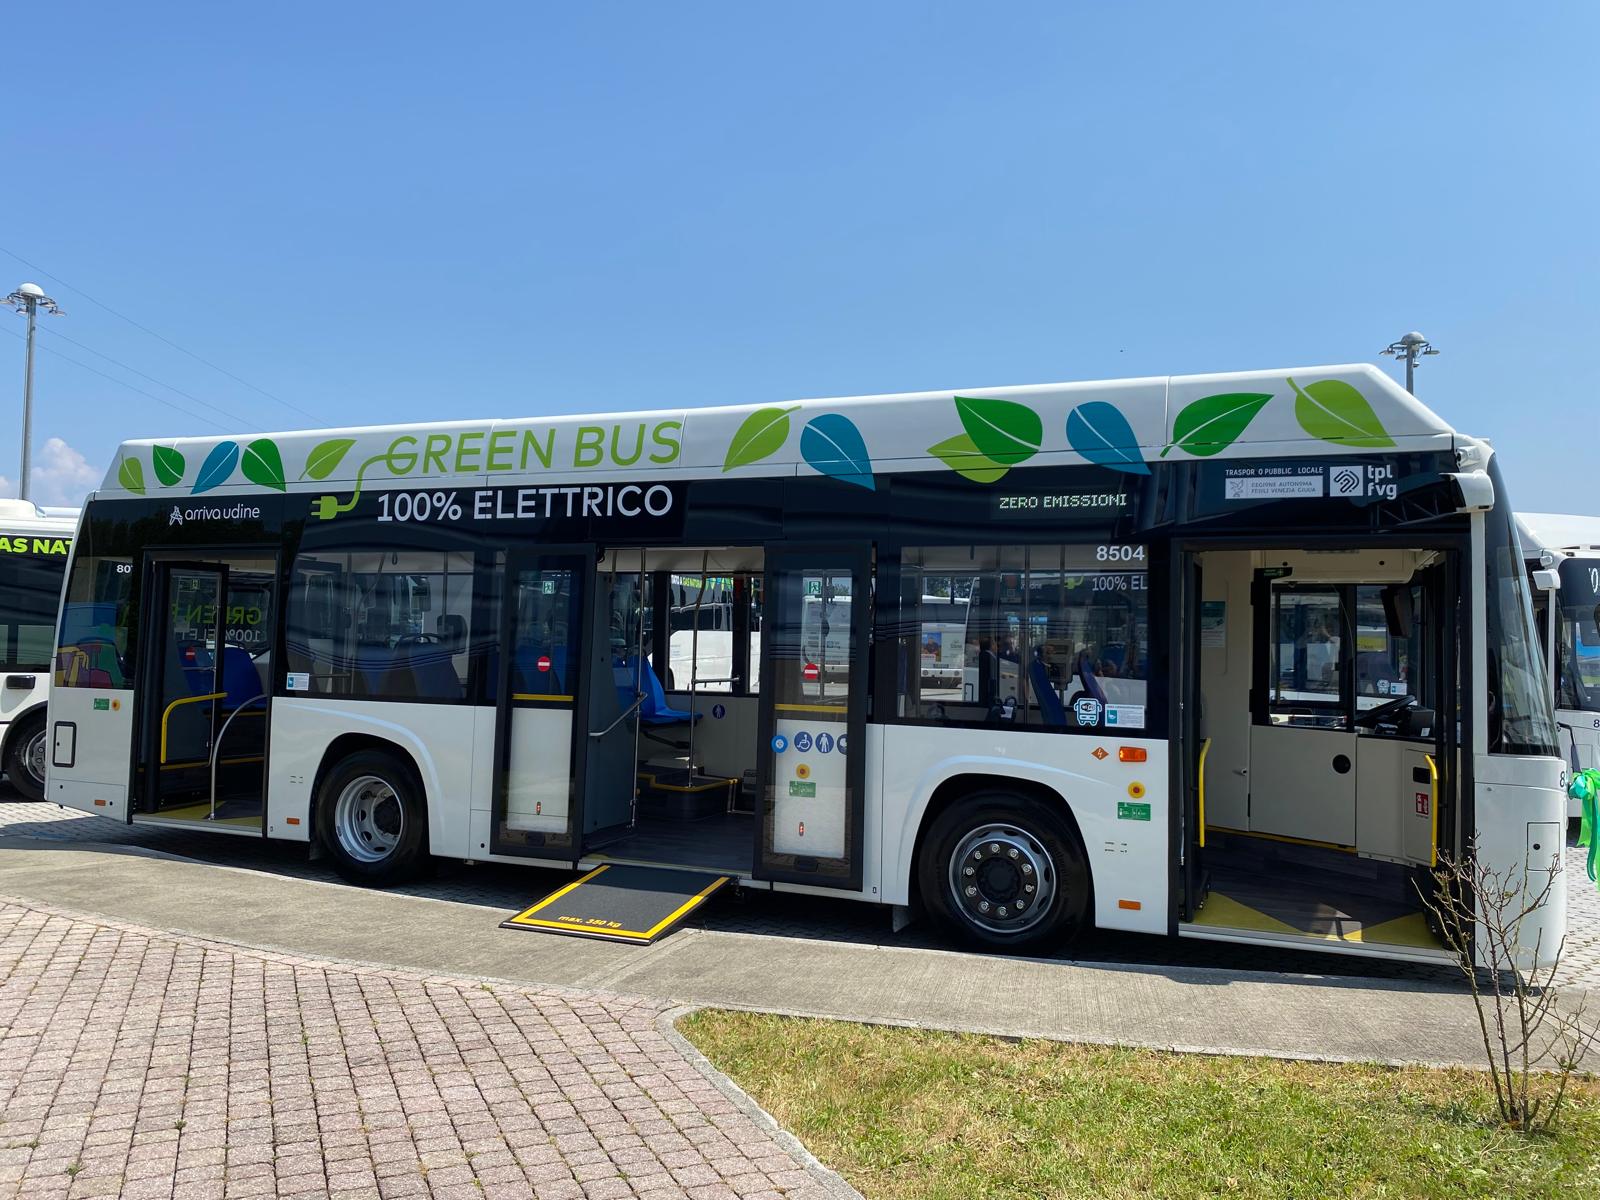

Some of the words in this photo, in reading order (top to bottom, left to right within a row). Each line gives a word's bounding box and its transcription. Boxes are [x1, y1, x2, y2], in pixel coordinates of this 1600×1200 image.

[386, 428, 556, 475] GREEN
[573, 421, 682, 467] BUS
[1264, 467, 1293, 475] PUBBLIC
[1298, 466, 1323, 474] LOCALE
[1367, 464, 1393, 483] tpl
[1367, 482, 1397, 500] fvg
[377, 490, 463, 522] 100%
[473, 485, 673, 520] ELETTRICO
[999, 496, 1038, 509] ZERO
[1043, 493, 1127, 508] EMISSIONI
[185, 506, 221, 521] arriva
[223, 503, 260, 519] udine
[1096, 545, 1145, 561] 8504
[116, 564, 133, 574] 80
[1092, 576, 1127, 592] 100%
[1130, 575, 1148, 590] EL
